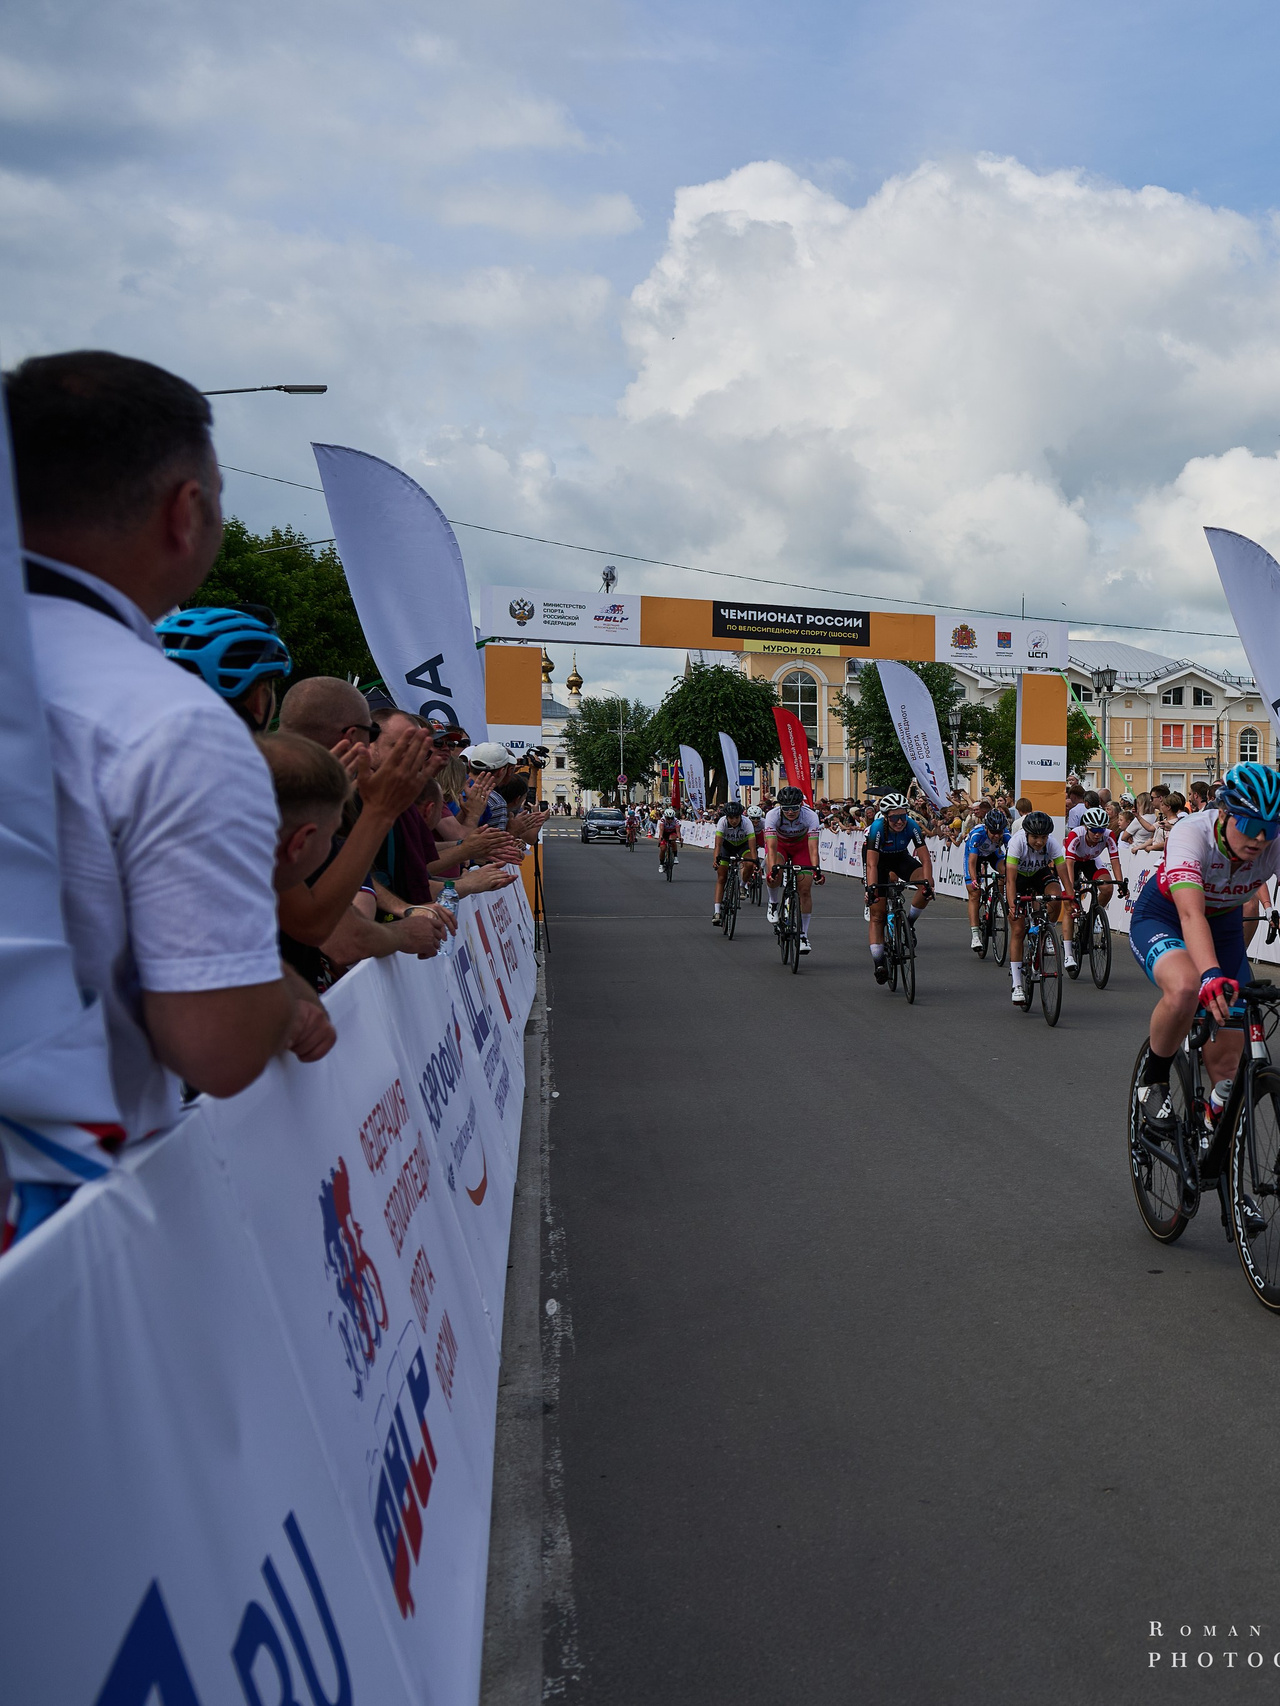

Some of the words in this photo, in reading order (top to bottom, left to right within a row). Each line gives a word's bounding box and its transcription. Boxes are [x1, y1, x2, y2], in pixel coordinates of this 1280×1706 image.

[543, 602, 586, 610] МИНИСТЕРСТВО
[720, 608, 804, 624] ЧЕМПИОНАТ
[806, 614, 863, 628] РОССИИ
[738, 625, 800, 635] ВЕЛОСИПЕДНОМУ
[800, 629, 828, 638] СПОРТУ
[829, 631, 859, 639] (ШОССЕ)
[763, 645, 798, 654] МУРОМ
[800, 646, 822, 655] 2024
[1028, 651, 1048, 659] ЦСП
[900, 704, 917, 761] ВЕЛОСИПЕДНОГО
[913, 734, 925, 760] СПОРТА
[920, 731, 931, 759] РОССИИ
[1203, 879, 1262, 895] ELARUS
[358, 1078, 410, 1178] ФЕДЕРАЦИЯ
[409, 1244, 436, 1334] СПОРТА
[435, 1309, 459, 1412] РОССИИ
